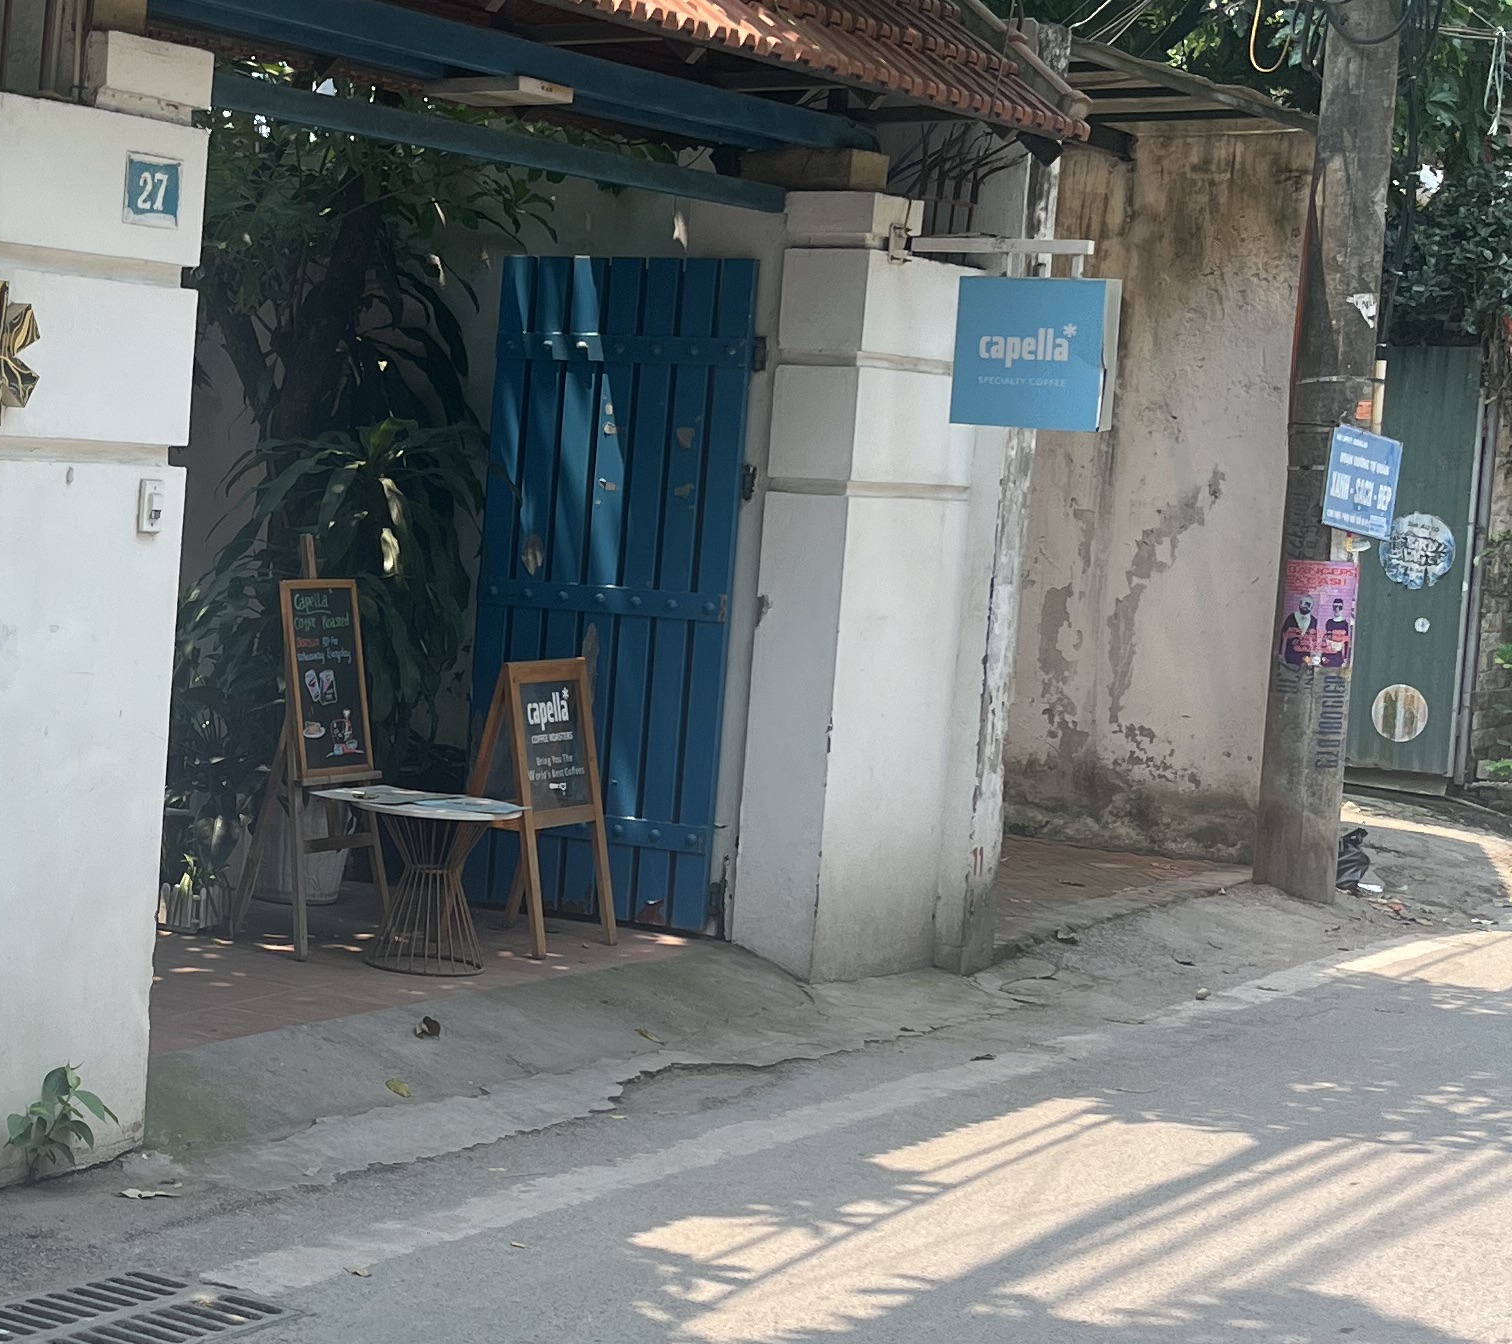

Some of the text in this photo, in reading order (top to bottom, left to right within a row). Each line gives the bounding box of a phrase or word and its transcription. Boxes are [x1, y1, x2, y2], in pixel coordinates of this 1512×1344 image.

[137, 171, 169, 211] 27
[978, 327, 1070, 368] capella
[977, 375, 1067, 388] SPECIALTY COFFEE
[527, 691, 570, 731] capella
[972, 846, 984, 877] 11
